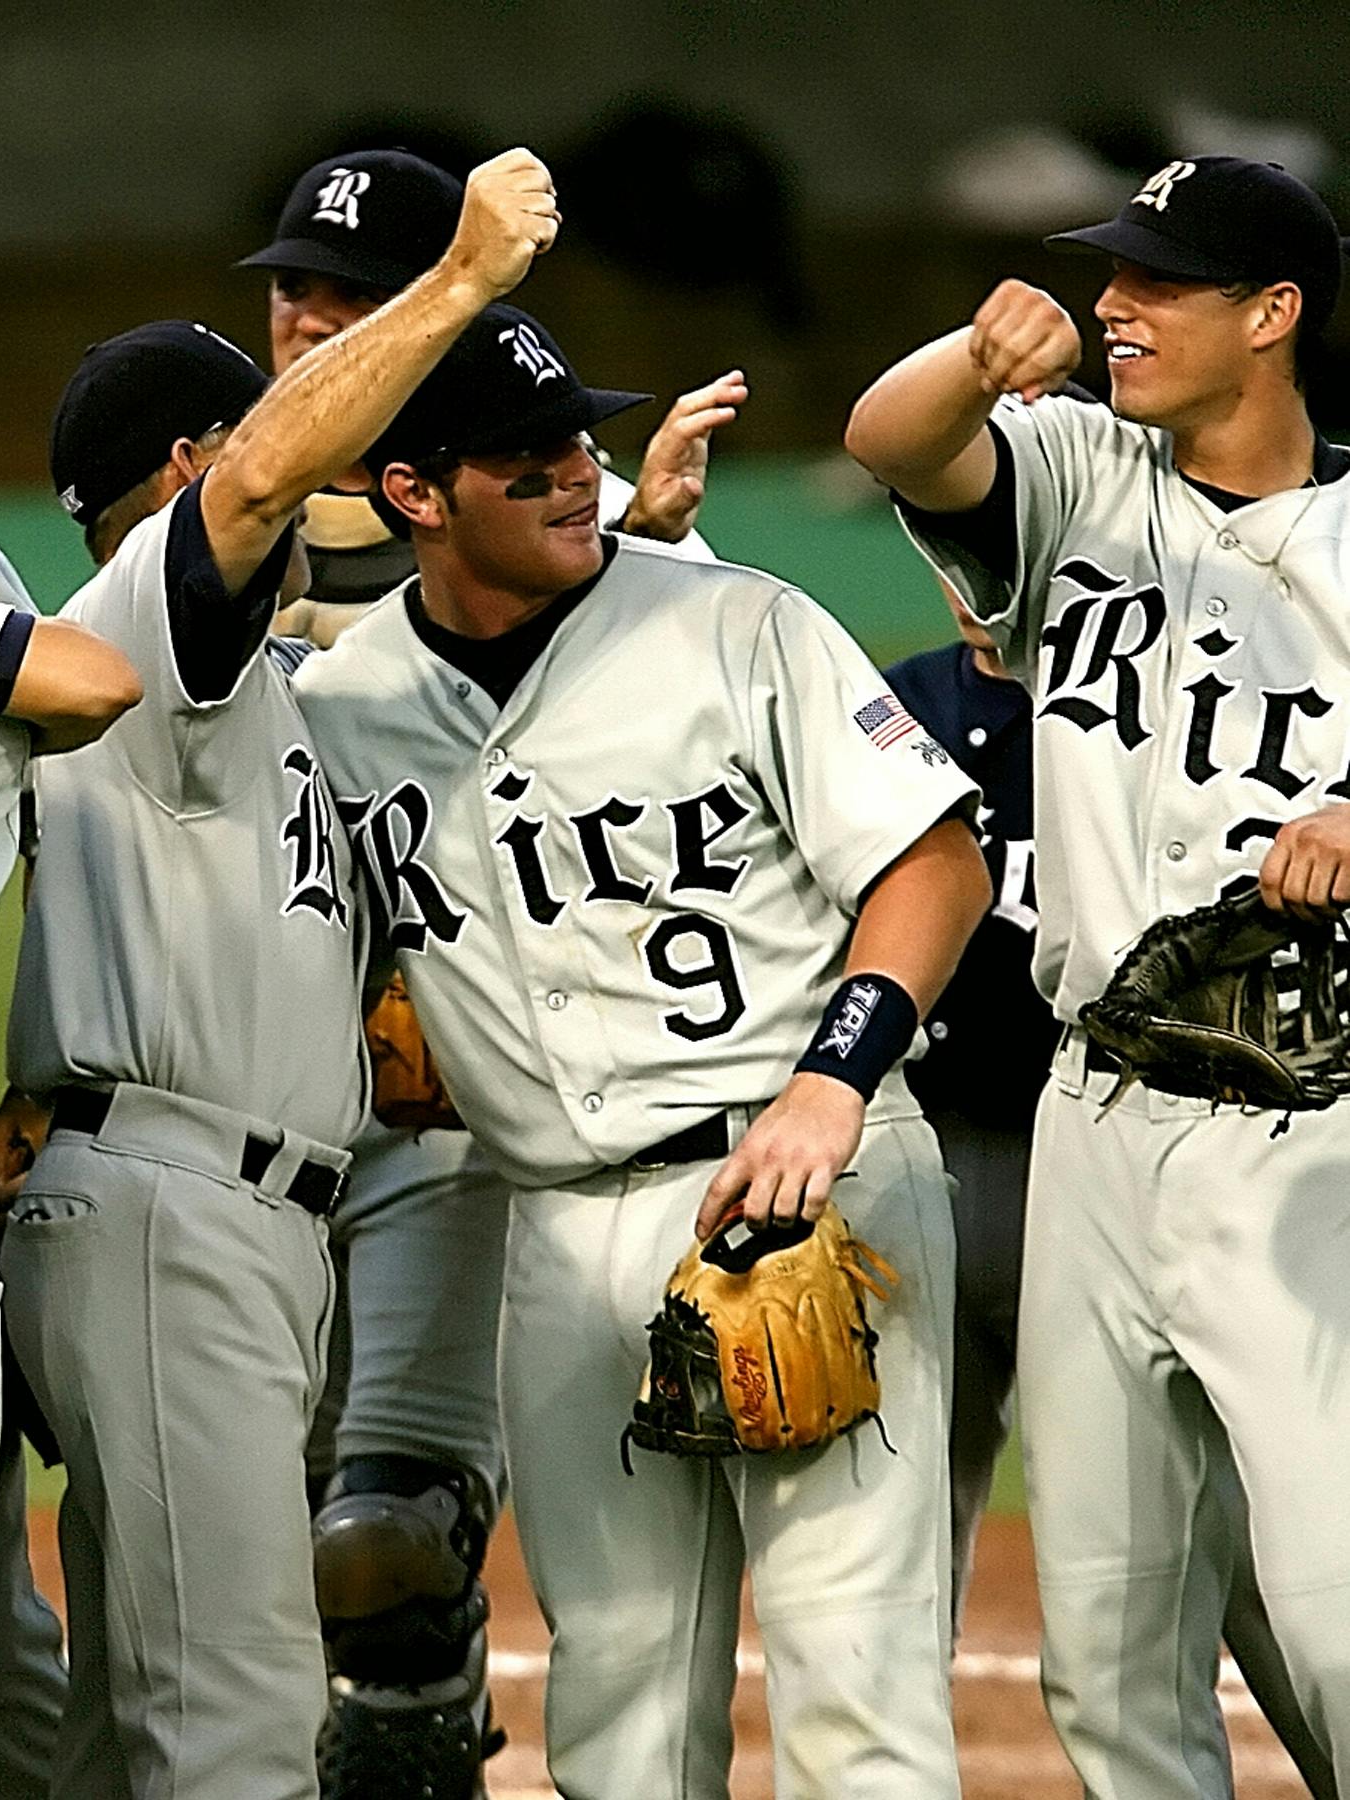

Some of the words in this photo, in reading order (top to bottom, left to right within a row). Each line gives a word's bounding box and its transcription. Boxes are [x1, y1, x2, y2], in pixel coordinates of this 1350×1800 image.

[314, 169, 370, 228] R
[1130, 161, 1197, 212] R
[499, 324, 565, 385] R
[1034, 555, 1350, 803] Ric
[335, 763, 758, 955] Rice
[637, 910, 748, 1045] 9
[817, 982, 882, 1060] TPX
